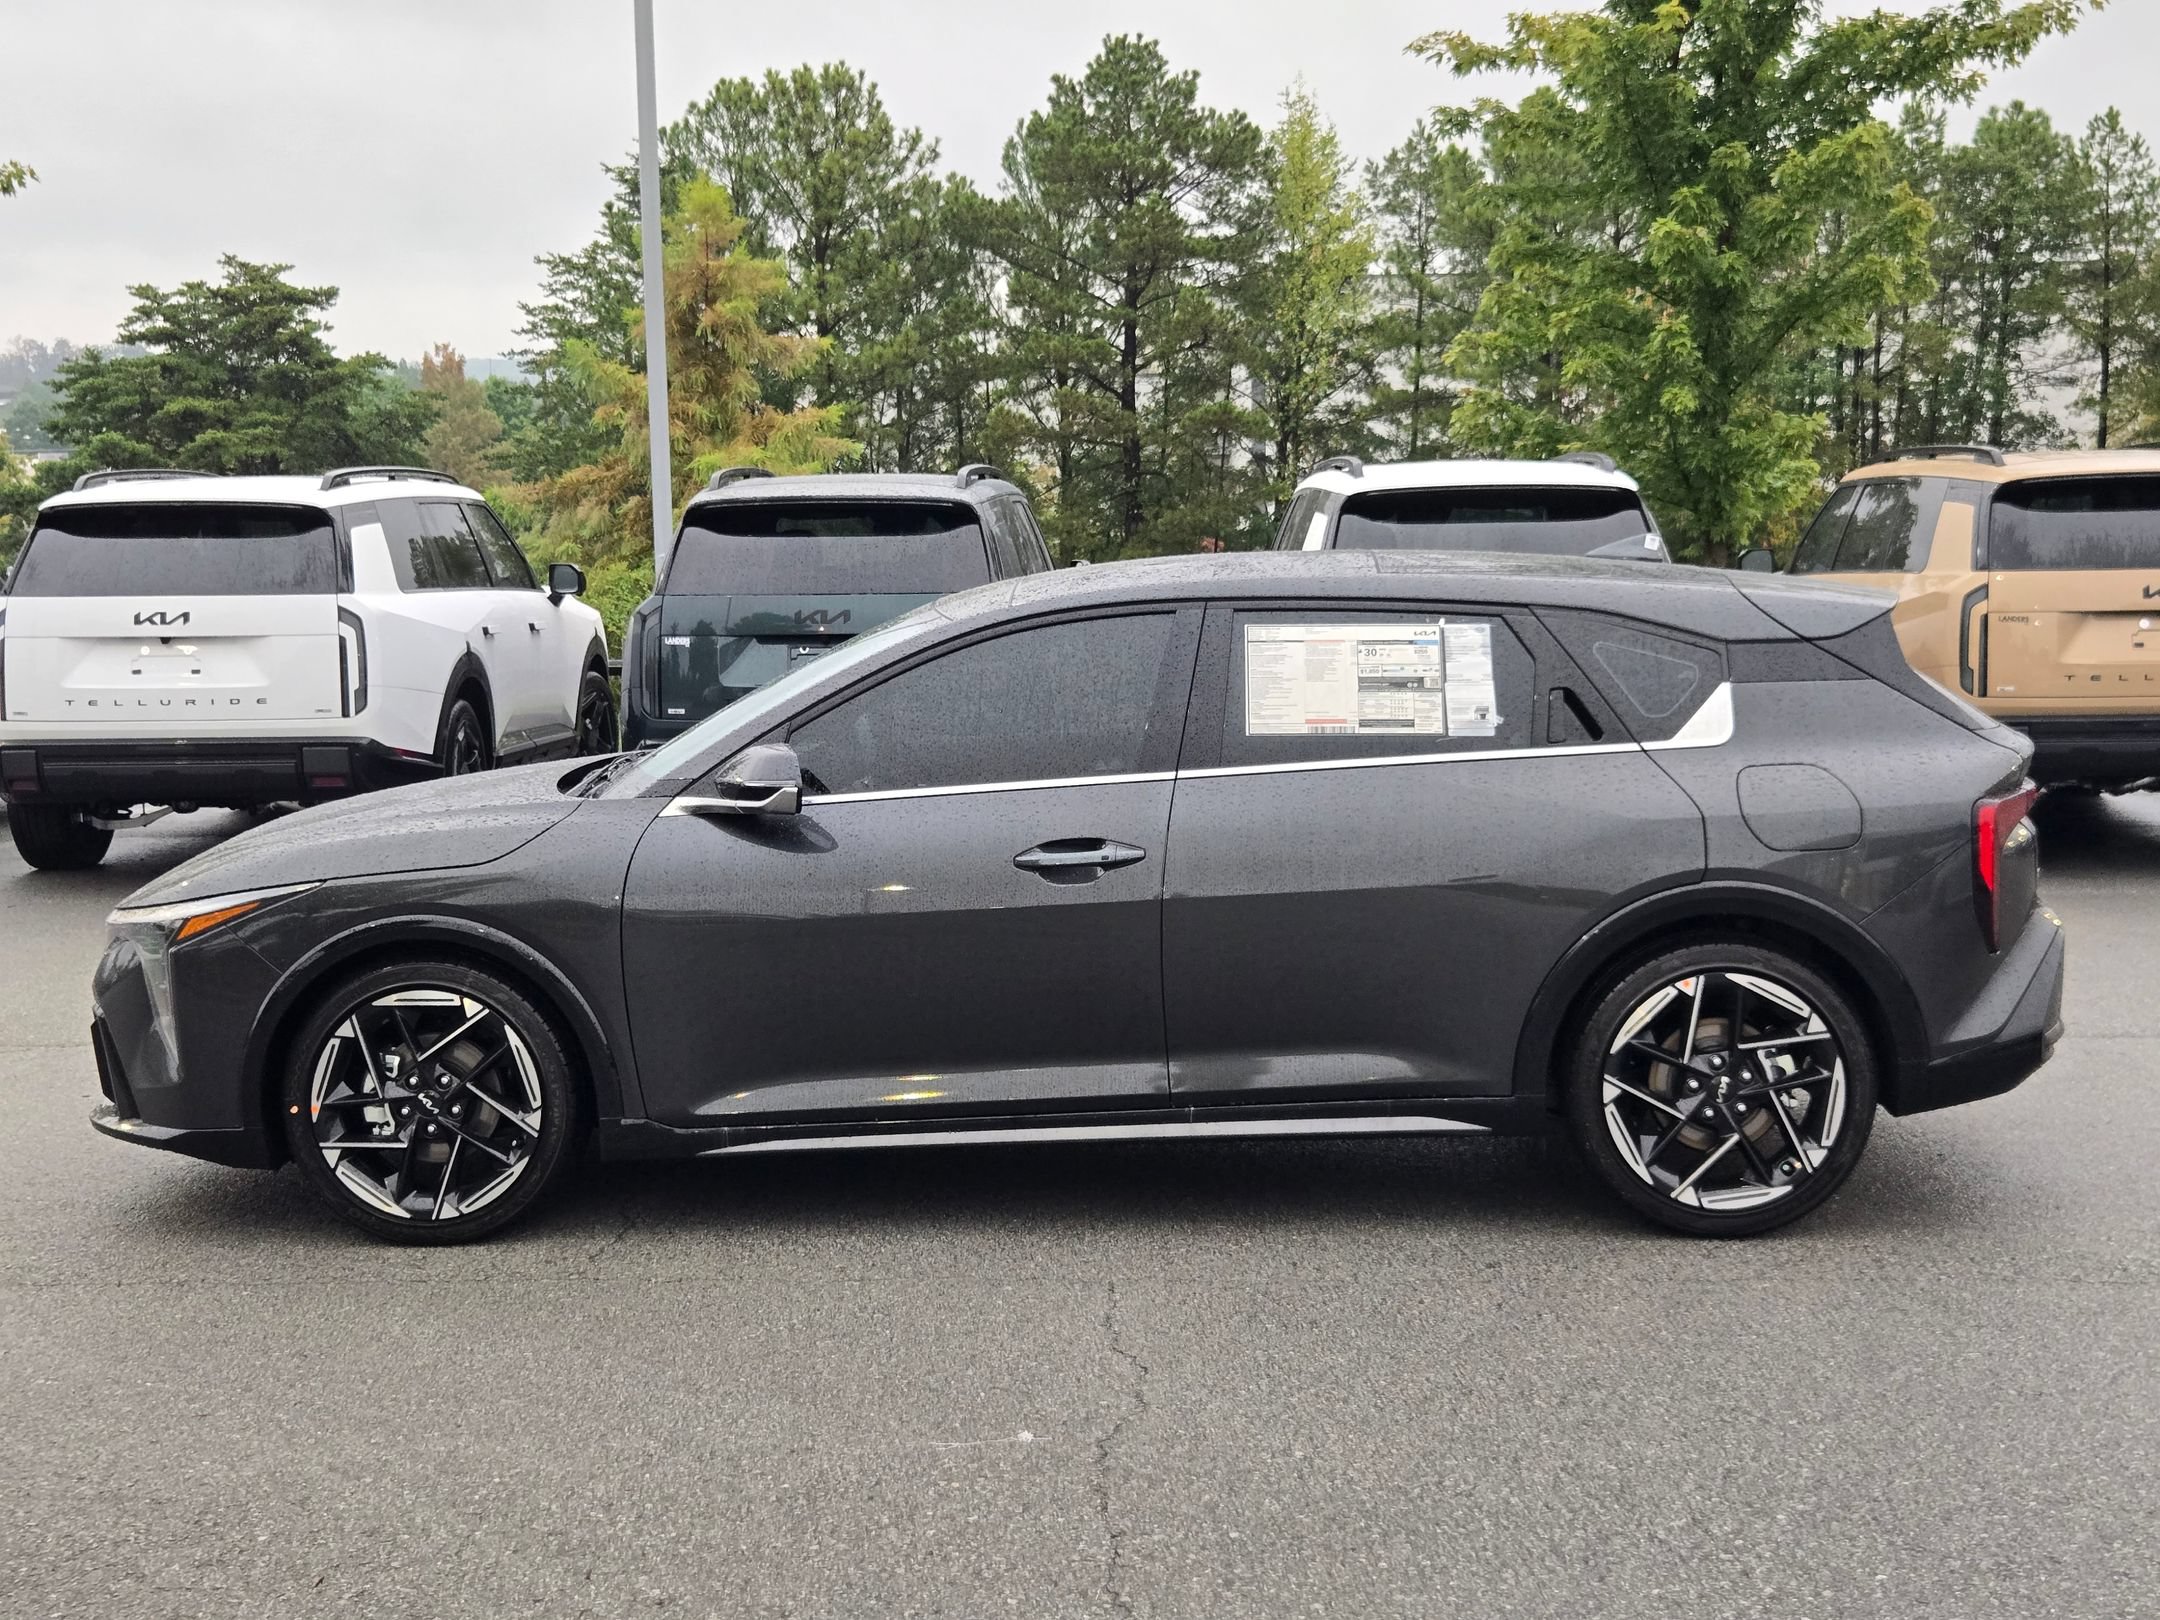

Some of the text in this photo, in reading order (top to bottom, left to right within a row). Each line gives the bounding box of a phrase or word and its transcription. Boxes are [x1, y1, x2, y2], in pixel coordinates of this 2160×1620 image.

[133, 611, 190, 626] KIA
[794, 609, 851, 625] KIA
[1364, 648, 1377, 657] 30
[65, 697, 268, 707] TELLURIDE
